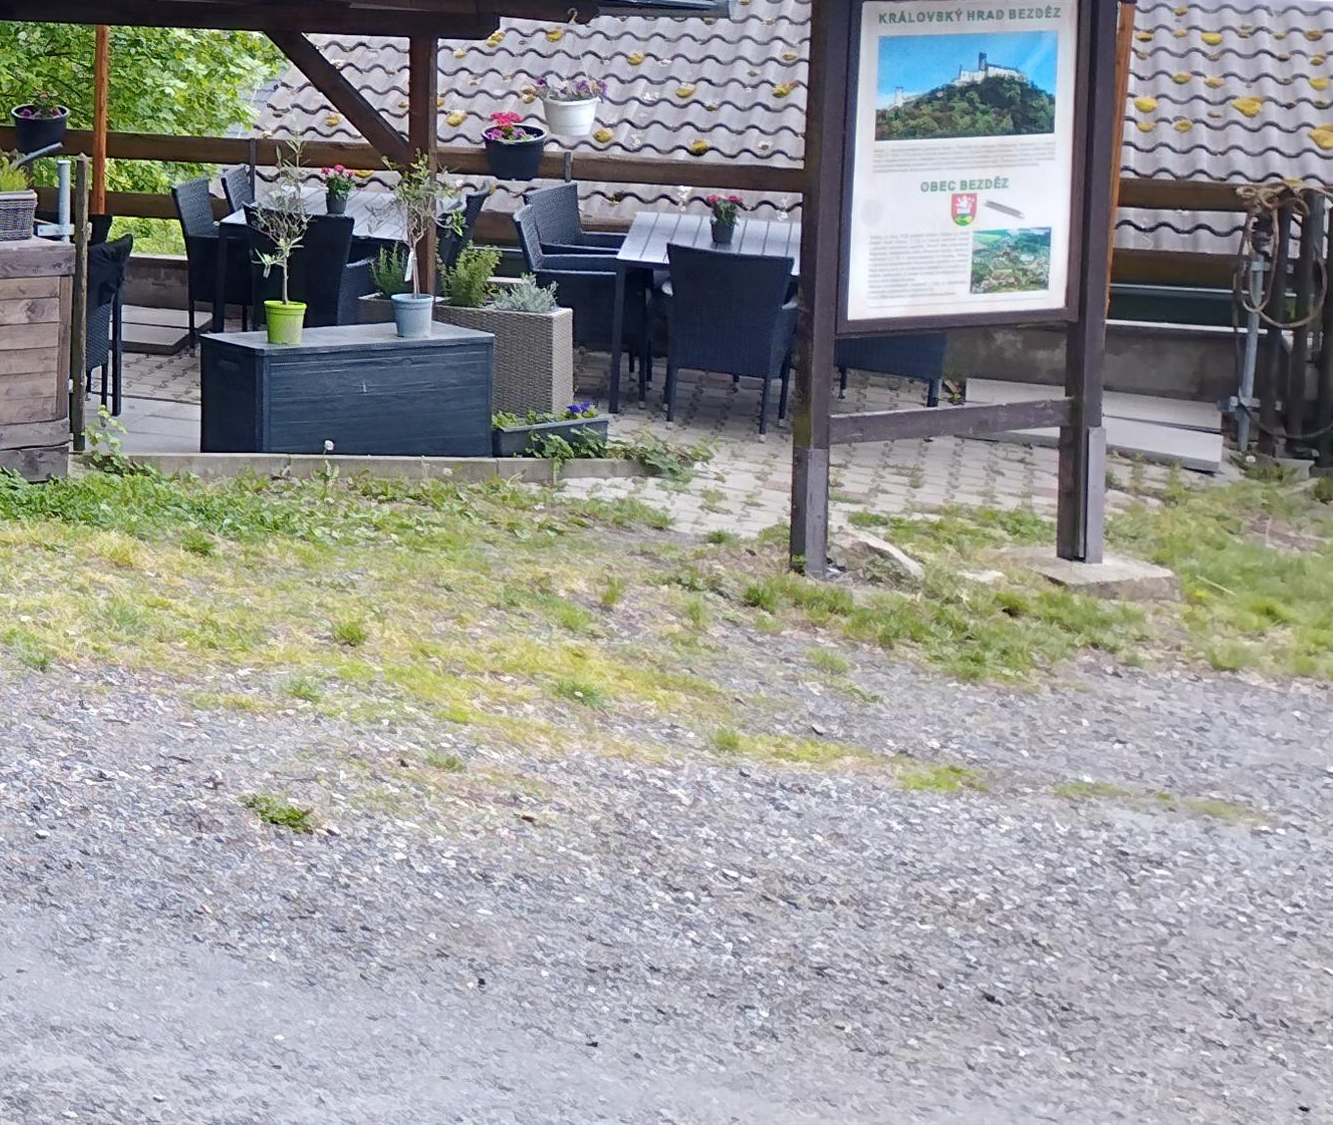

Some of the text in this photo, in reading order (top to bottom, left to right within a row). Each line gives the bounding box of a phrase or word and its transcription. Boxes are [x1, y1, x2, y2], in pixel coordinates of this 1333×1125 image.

[878, 5, 1061, 24] KRÁLOVSKÝ HRAD BEZDĚZ
[920, 176, 1009, 192] OBEC BEZDĚZ
